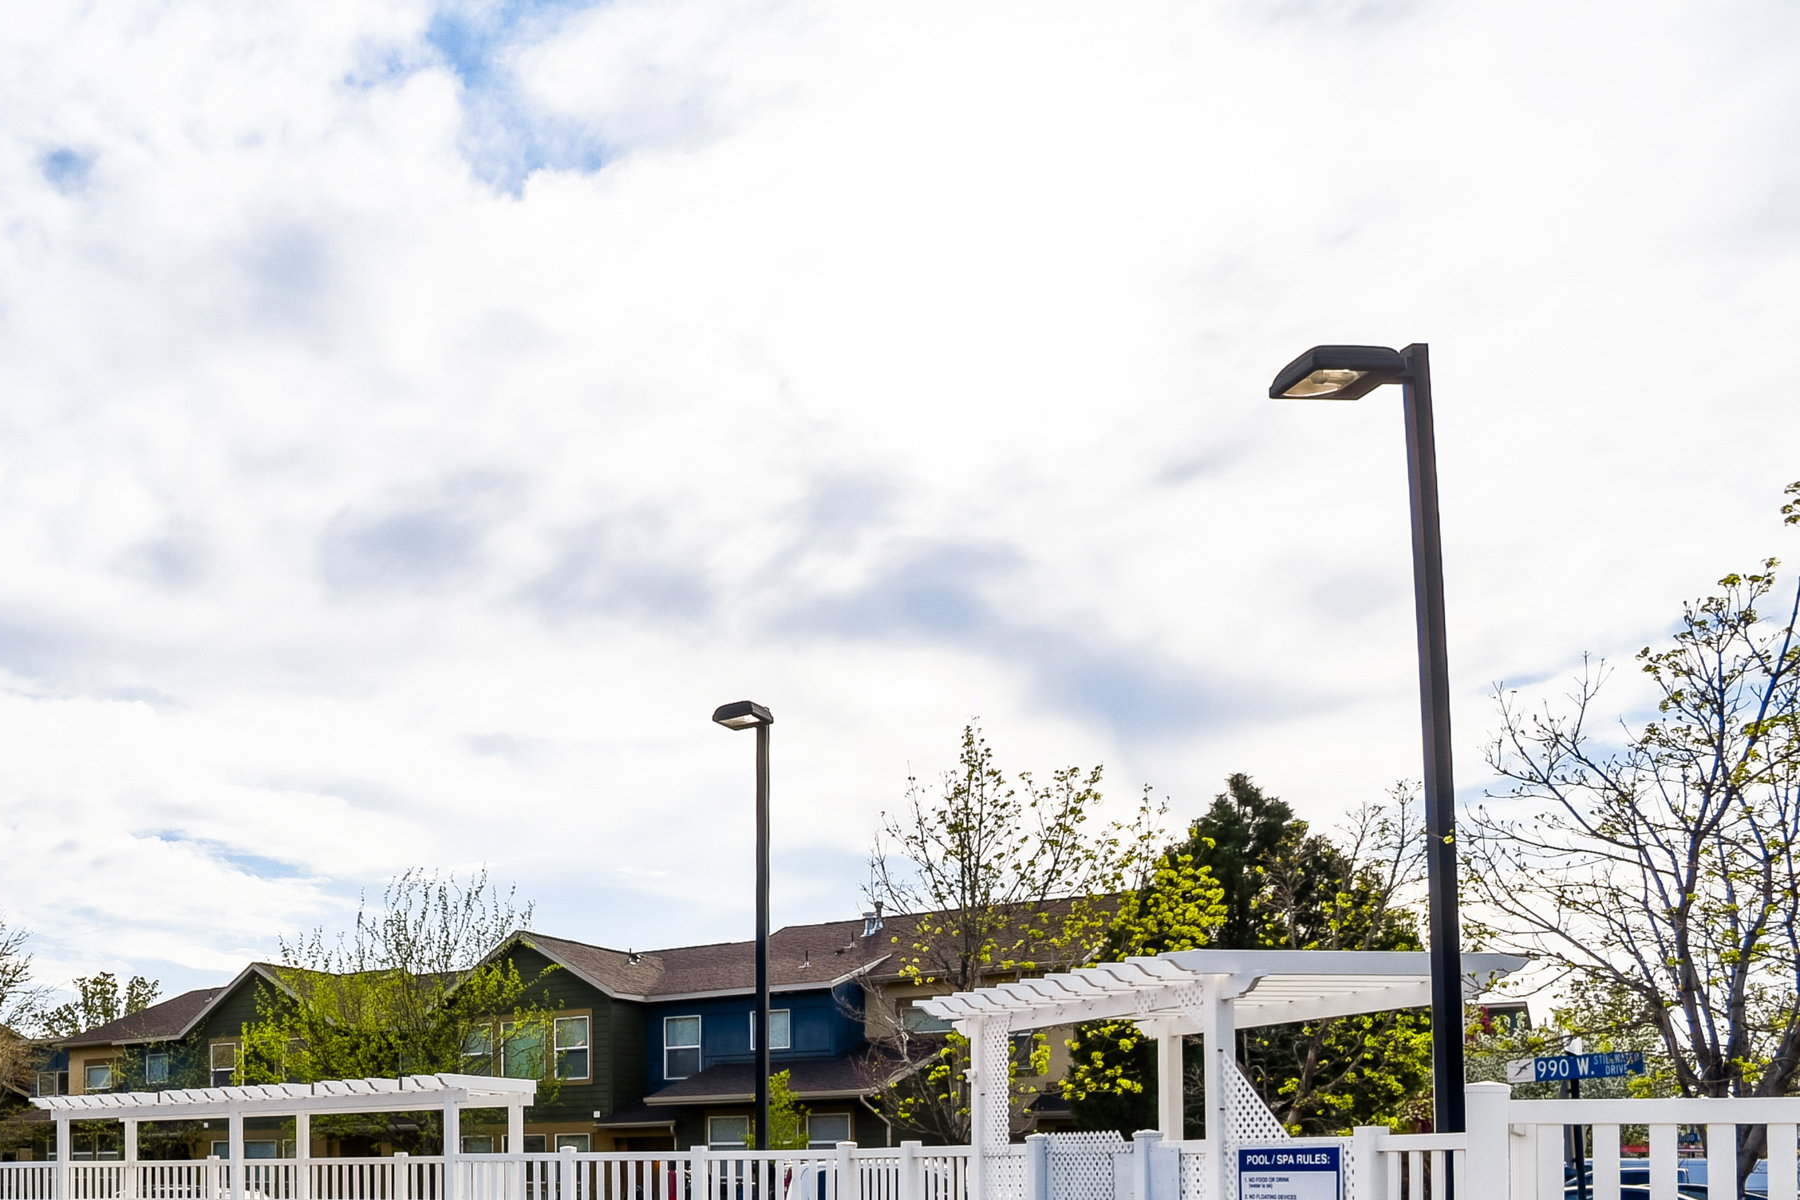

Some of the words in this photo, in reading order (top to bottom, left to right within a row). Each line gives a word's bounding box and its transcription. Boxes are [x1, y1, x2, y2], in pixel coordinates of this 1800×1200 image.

[1537, 1058, 1570, 1078] 990
[1576, 1057, 1594, 1076] W.
[1246, 1154, 1270, 1165] POOL
[1271, 1154, 1275, 1164] /
[1276, 1154, 1294, 1164] SPA
[1296, 1153, 1330, 1164] RULES:
